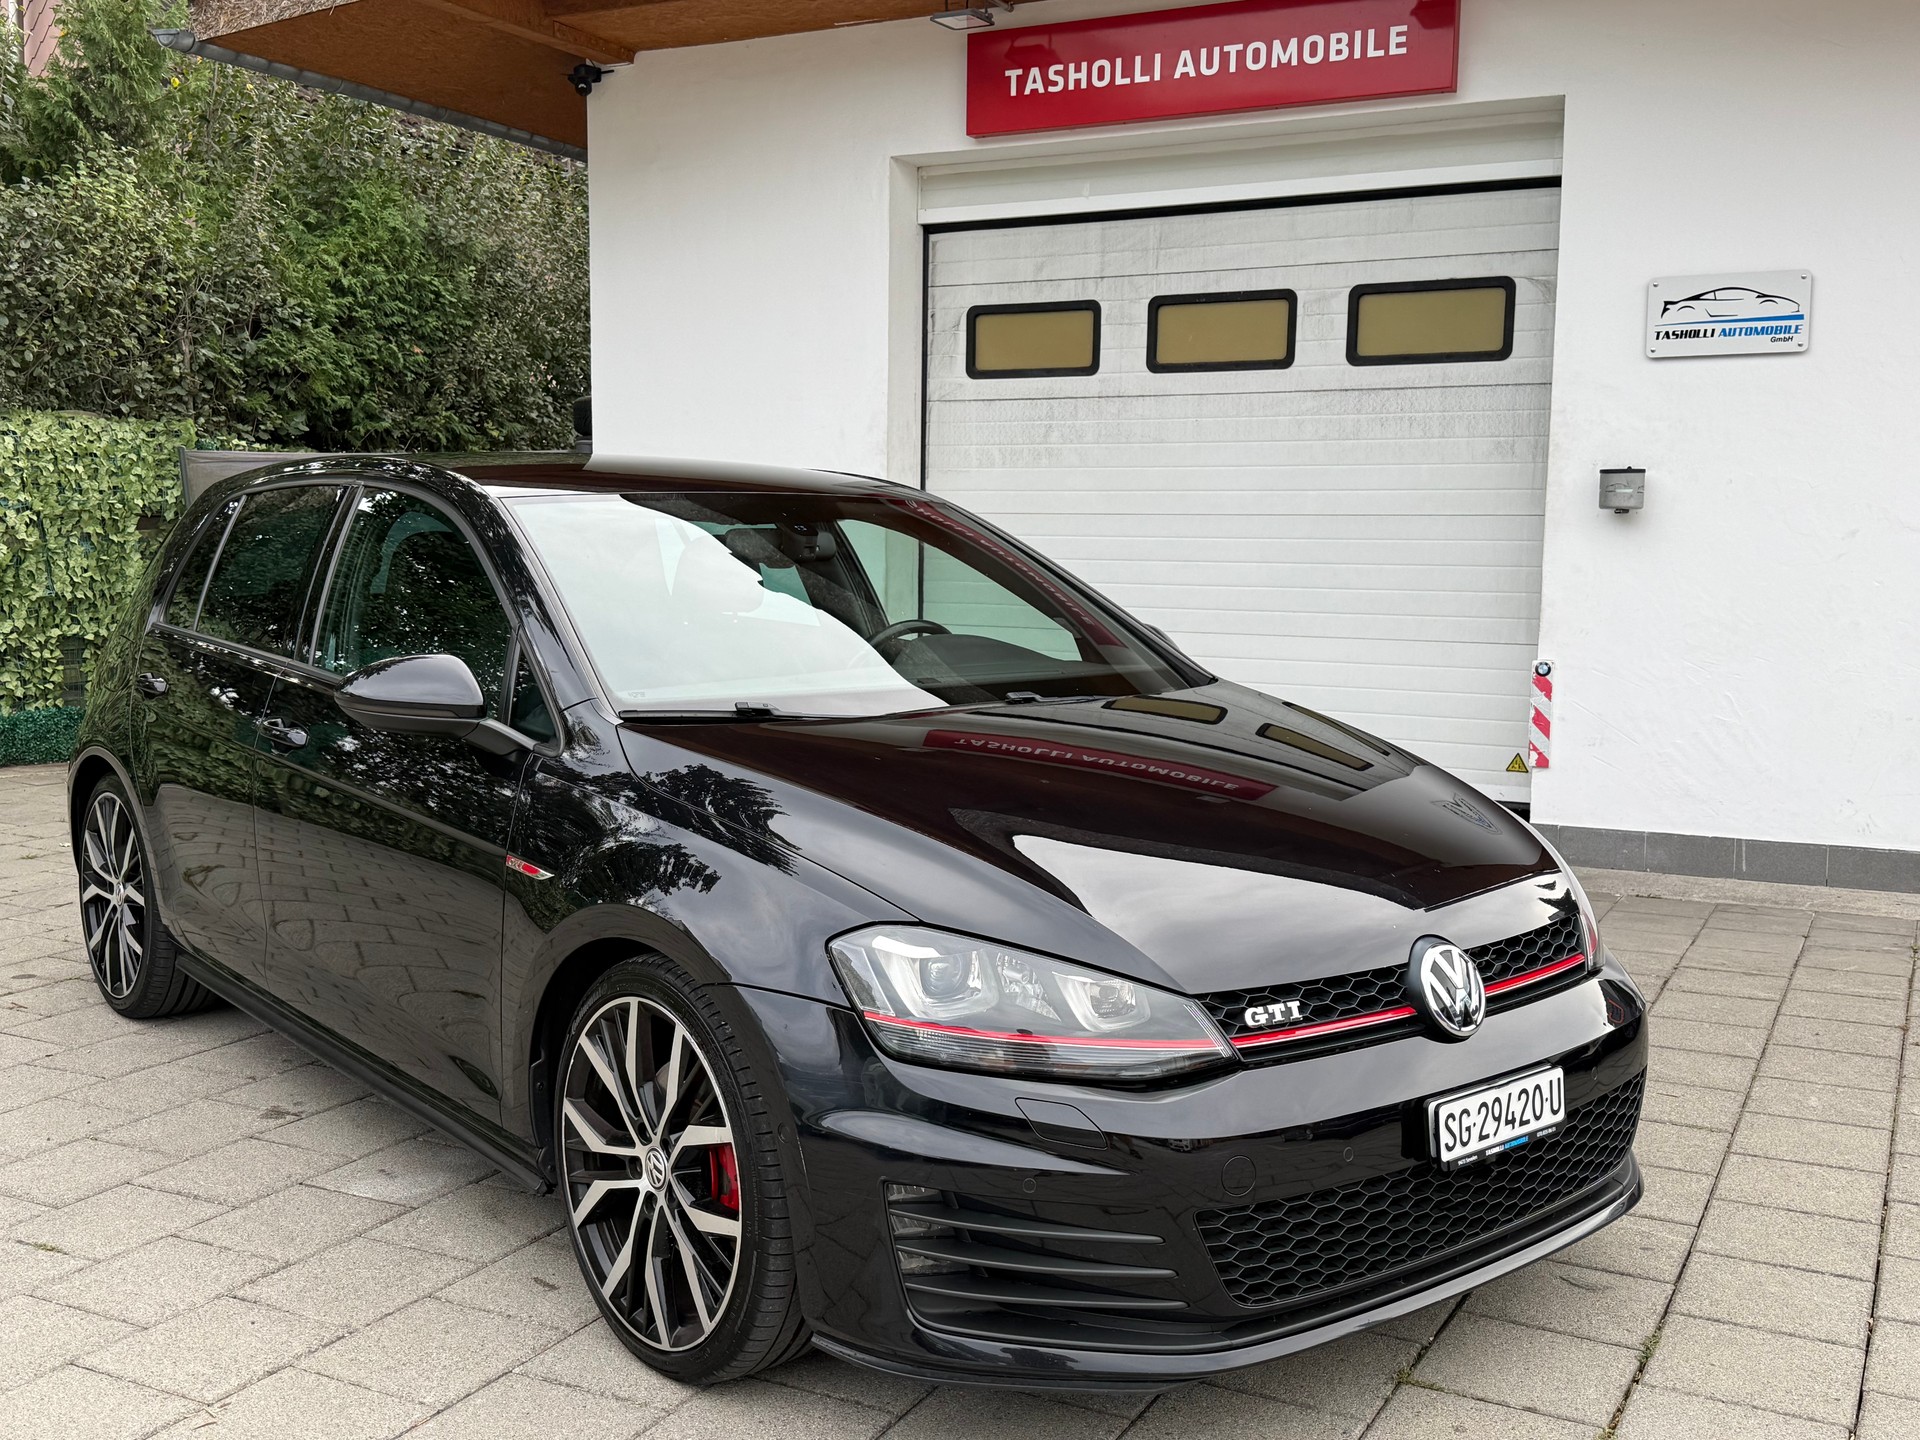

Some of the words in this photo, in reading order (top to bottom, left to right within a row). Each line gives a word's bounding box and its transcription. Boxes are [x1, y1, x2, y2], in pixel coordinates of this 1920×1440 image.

[1005, 53, 1161, 97] TASHOLLI
[1174, 25, 1408, 80] AUTOMOBILE
[1655, 328, 1716, 341] TASHOLLI
[1718, 324, 1804, 338] AUTOMOBILE
[1244, 1001, 1303, 1028] GTI
